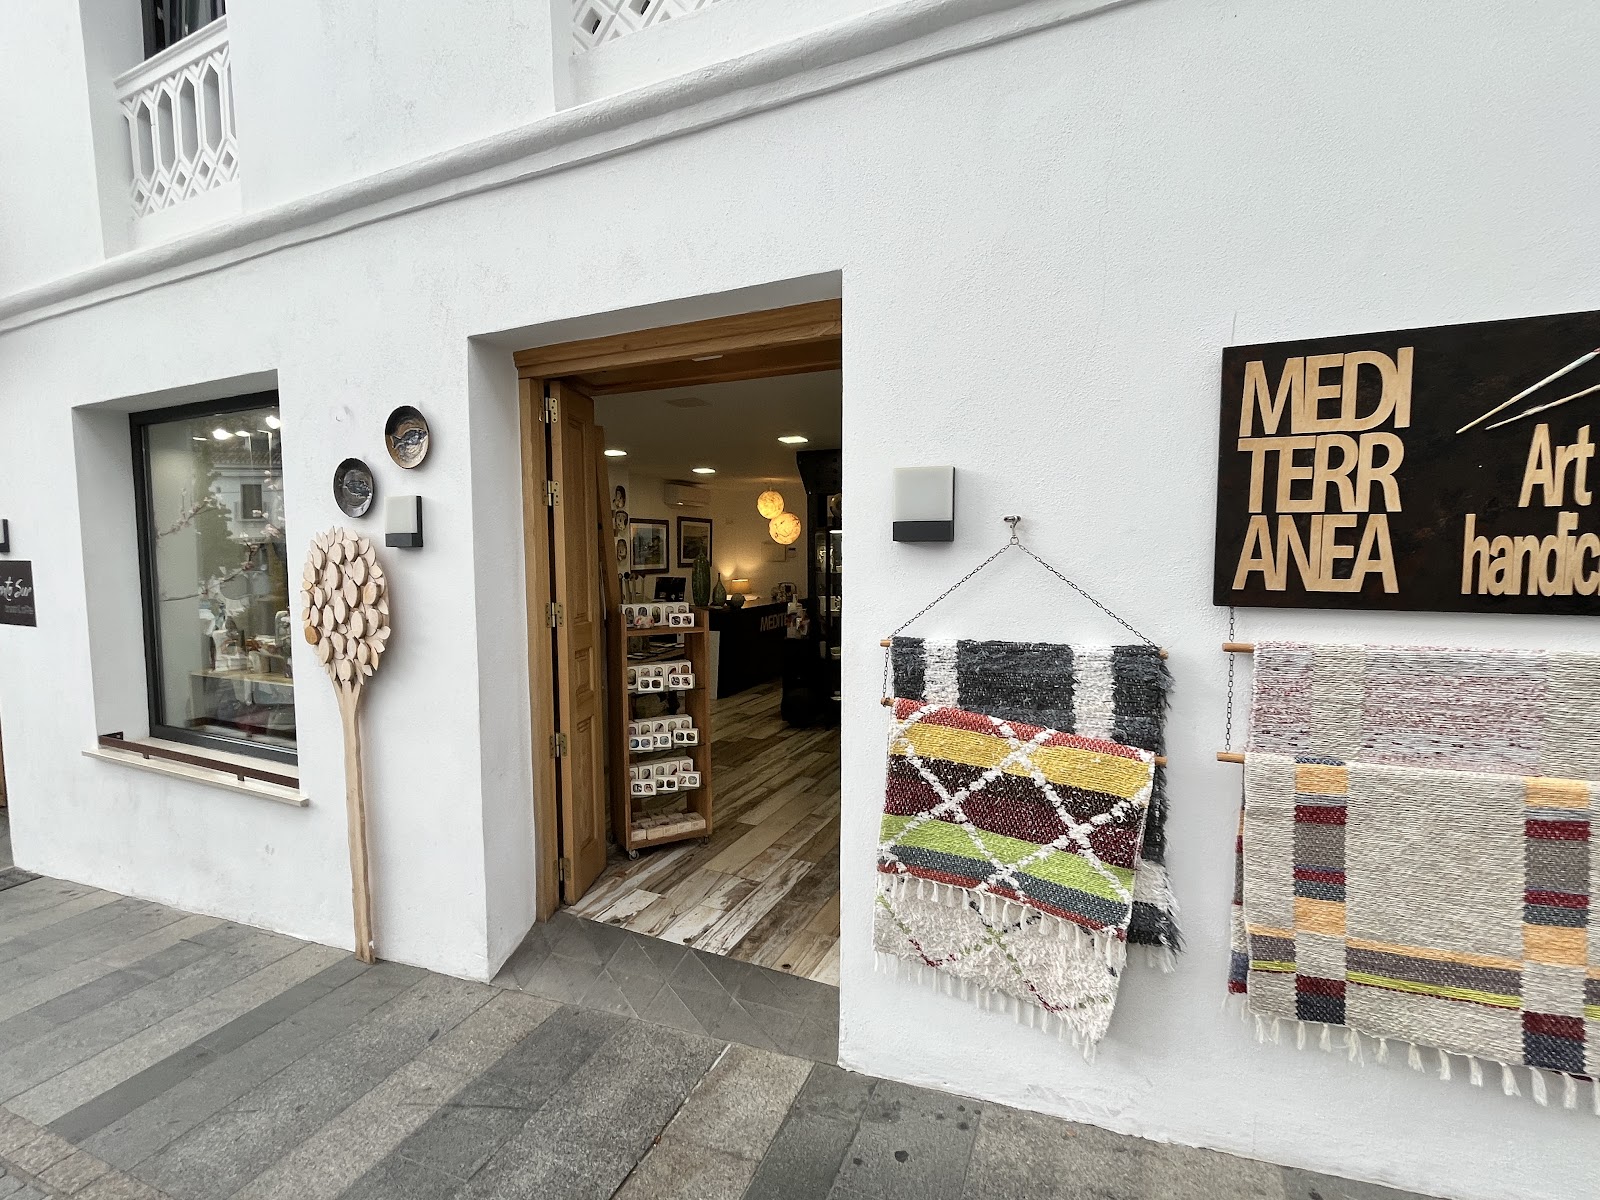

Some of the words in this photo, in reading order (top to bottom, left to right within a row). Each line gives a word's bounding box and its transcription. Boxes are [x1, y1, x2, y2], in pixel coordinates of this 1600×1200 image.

[1238, 346, 1414, 437] MEDI
[1237, 432, 1404, 513] TERR
[1517, 423, 1595, 508] Art
[1232, 514, 1399, 593] ANEA
[1461, 511, 1600, 596] handic
